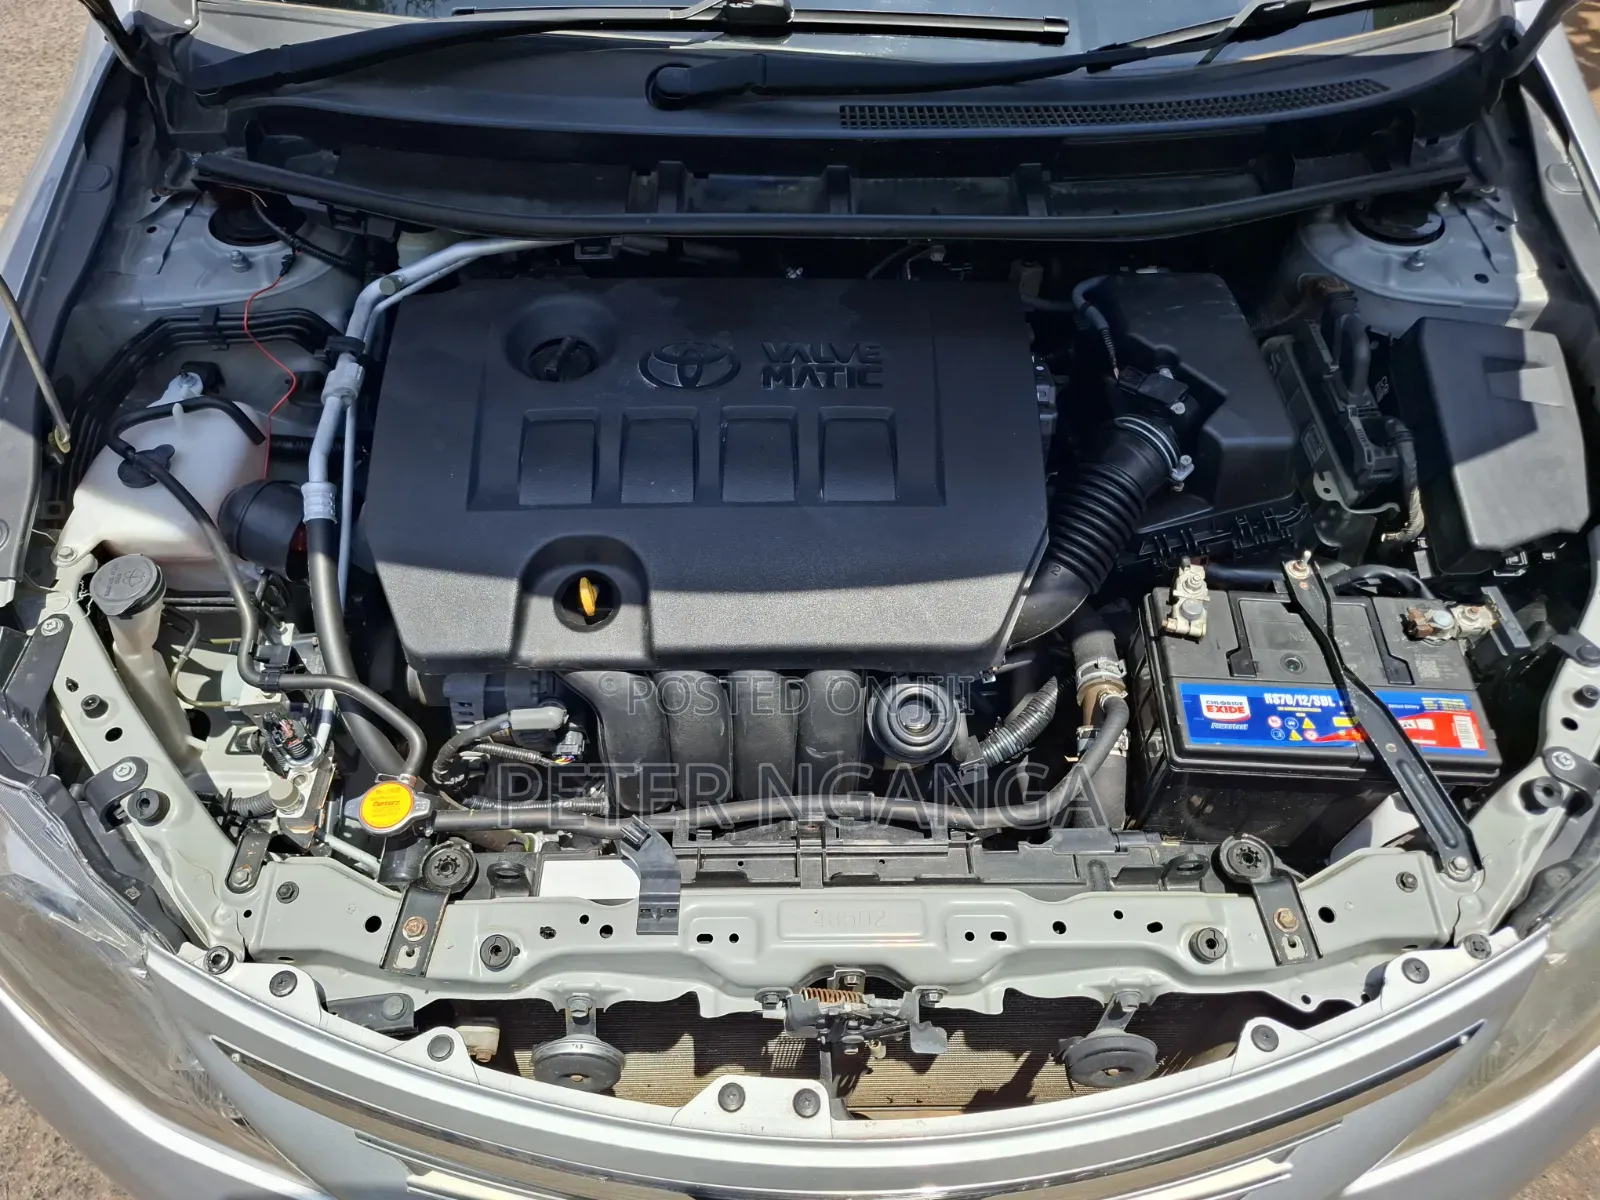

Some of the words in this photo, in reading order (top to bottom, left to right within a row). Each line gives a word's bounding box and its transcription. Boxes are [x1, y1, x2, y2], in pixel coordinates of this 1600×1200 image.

[760, 341, 883, 364] VALVE
[761, 365, 884, 390] MATIC
[1206, 705, 1246, 714] EXIDE
